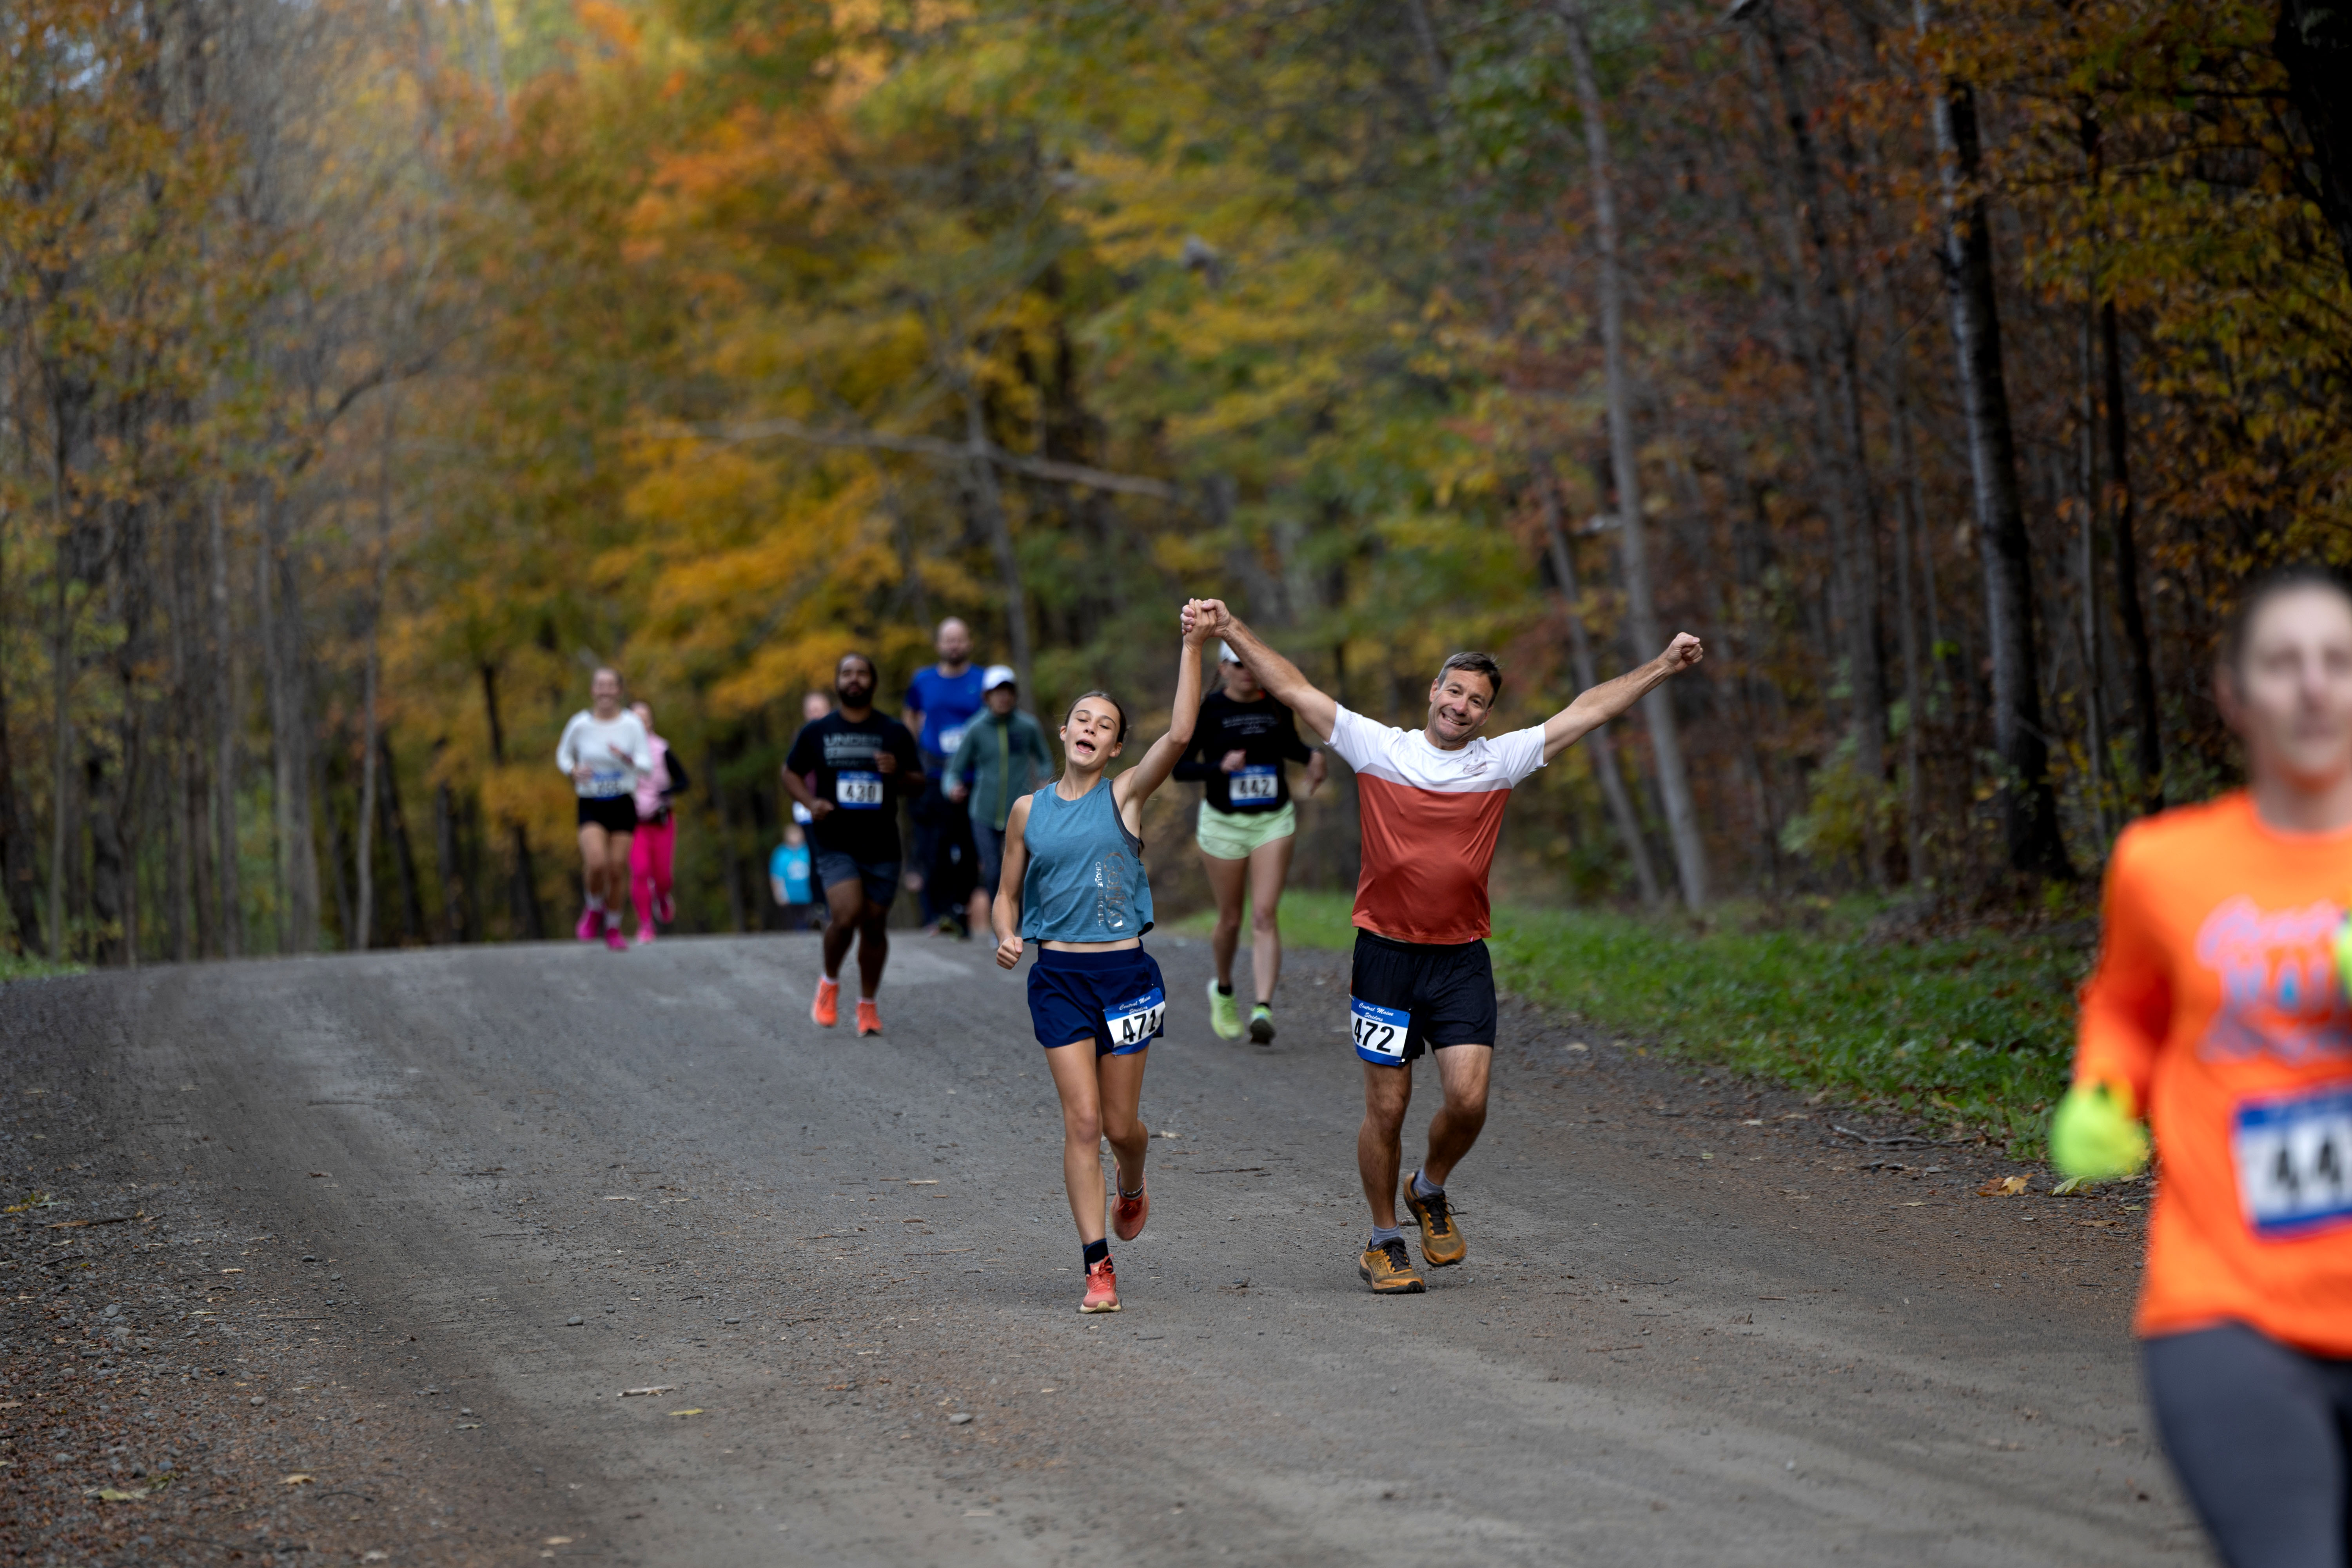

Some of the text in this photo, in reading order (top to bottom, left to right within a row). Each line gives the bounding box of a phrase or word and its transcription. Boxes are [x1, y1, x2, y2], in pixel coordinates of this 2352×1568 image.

[845, 784, 876, 802] 430
[1240, 779, 1271, 797] 442
[1119, 1001, 1138, 1010] Central
[1129, 1005, 1148, 1014] Striders
[1359, 1002, 1394, 1016] Central Maine
[1364, 1012, 1383, 1022] Striders
[1123, 1009, 1156, 1043] 471
[1354, 1018, 1395, 1053] 472
